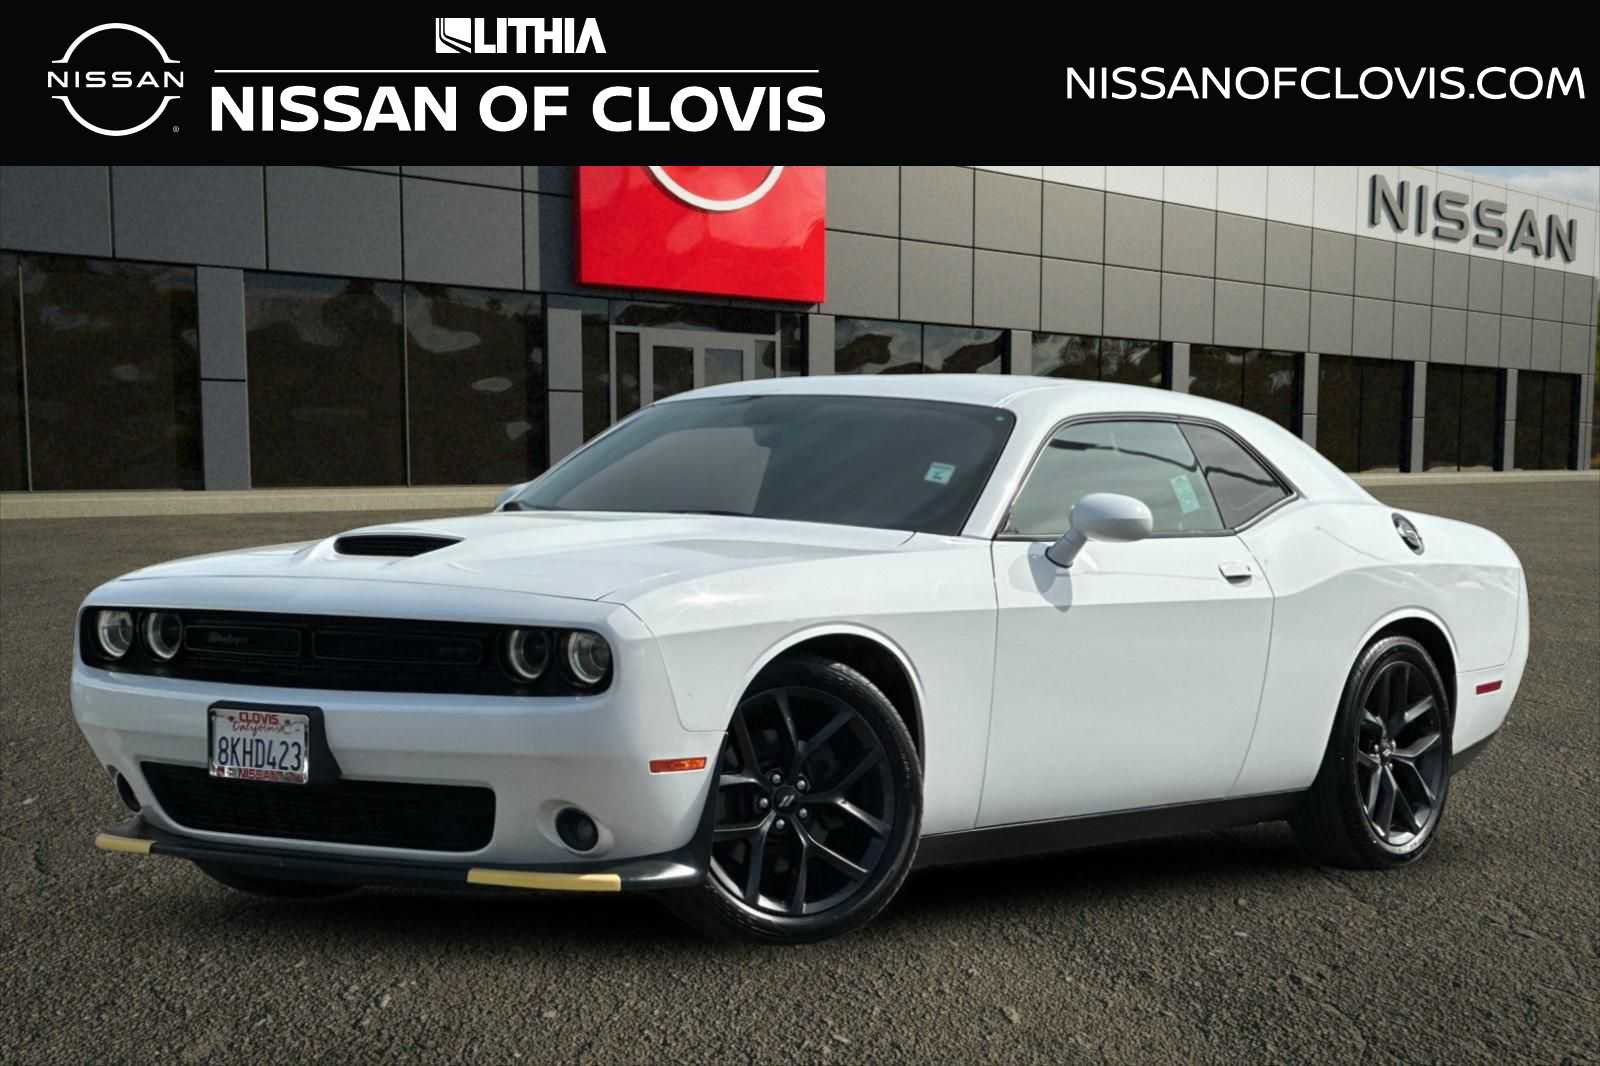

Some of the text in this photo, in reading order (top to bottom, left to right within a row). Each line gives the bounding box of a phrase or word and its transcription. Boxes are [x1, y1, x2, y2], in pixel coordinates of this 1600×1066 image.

[1368, 174, 1577, 262] NISSAN
[239, 711, 279, 725] CLOVIS
[218, 736, 302, 771] 8KHD423
